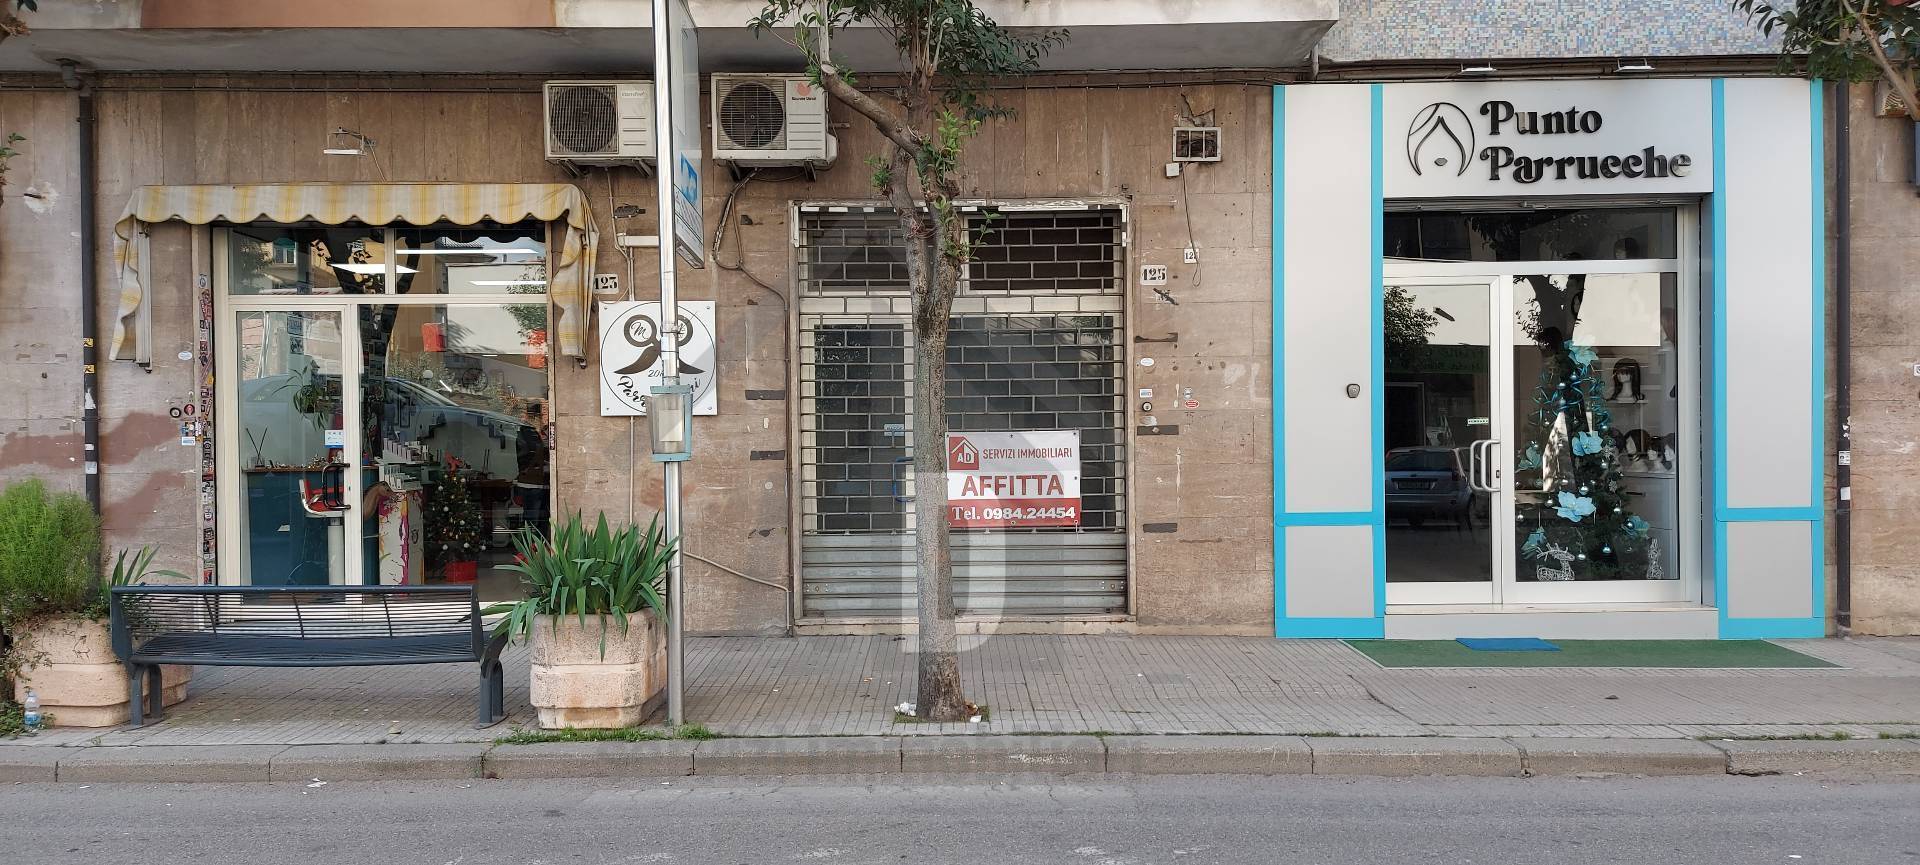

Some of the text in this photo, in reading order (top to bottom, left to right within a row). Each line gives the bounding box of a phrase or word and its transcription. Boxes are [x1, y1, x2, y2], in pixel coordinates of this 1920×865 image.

[1479, 100, 1603, 135] Punto
[1479, 145, 1692, 185] Parrucche
[1143, 268, 1166, 281] 125
[594, 276, 618, 290] 123
[982, 447, 1073, 459] SERVIZI IMMOBILIARI
[961, 474, 1065, 497] AFFITTA
[951, 506, 1076, 521] Tel. 0984.24454
